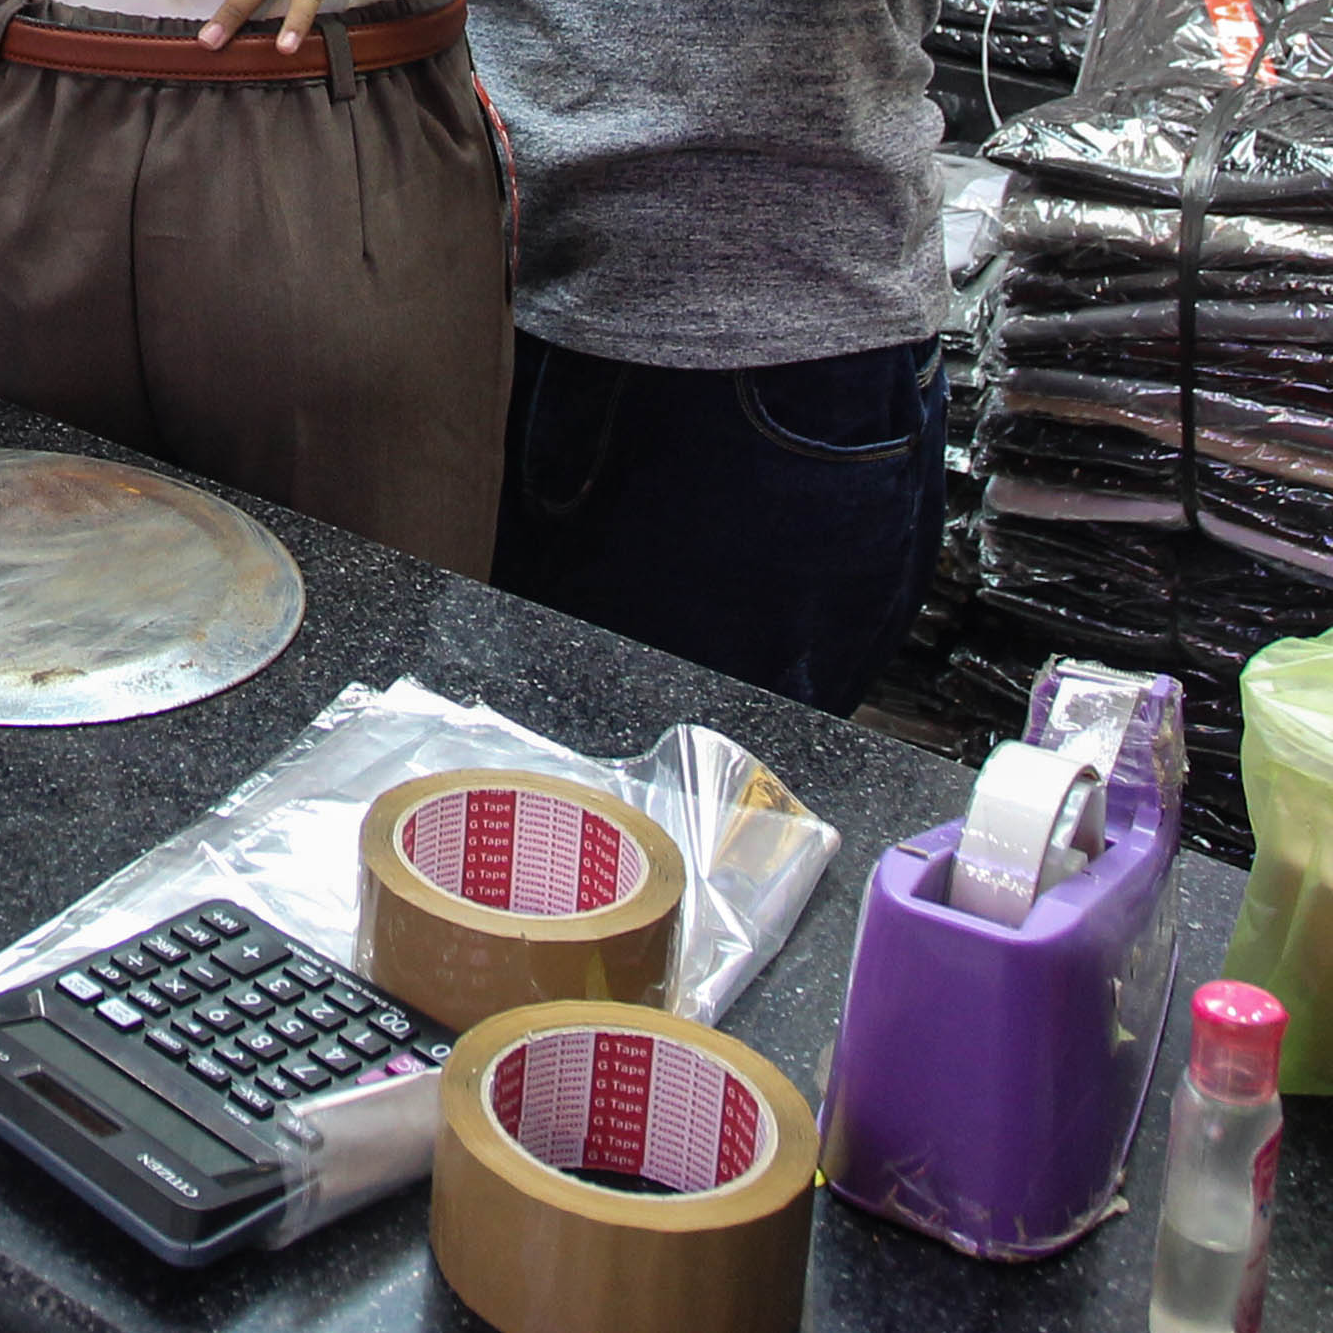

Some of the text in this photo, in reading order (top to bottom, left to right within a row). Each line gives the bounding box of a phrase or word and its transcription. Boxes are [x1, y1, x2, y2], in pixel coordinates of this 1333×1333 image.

[470, 802, 511, 813] G Tape
[469, 819, 510, 830] G Tape
[468, 836, 509, 847] G Tape
[467, 852, 508, 863] G Tape
[466, 869, 507, 880] G Tape
[465, 886, 506, 897] G Tape
[149, 935, 181, 957] MRC
[285, 942, 323, 967] RECHECK
[99, 966, 120, 980] GT
[269, 979, 290, 992] 3
[334, 972, 362, 992] CHECK
[136, 991, 162, 1008] MU
[240, 992, 262, 1005] 6
[208, 1010, 230, 1022] 9
[312, 1003, 334, 1019] 2
[280, 1020, 304, 1035] 5
[379, 1013, 410, 1033] 00
[251, 1034, 273, 1049] 8
[354, 1031, 371, 1046] 1
[325, 1047, 346, 1060] 4
[431, 1043, 451, 1058] 0
[599, 1042, 648, 1058] G Tape
[292, 1065, 318, 1079] 7
[598, 1060, 646, 1076] G Tape
[596, 1079, 644, 1095] G Tape
[595, 1098, 643, 1113] G Tape
[593, 1116, 641, 1131] G Tape
[136, 1152, 199, 1198] CITIZEN
